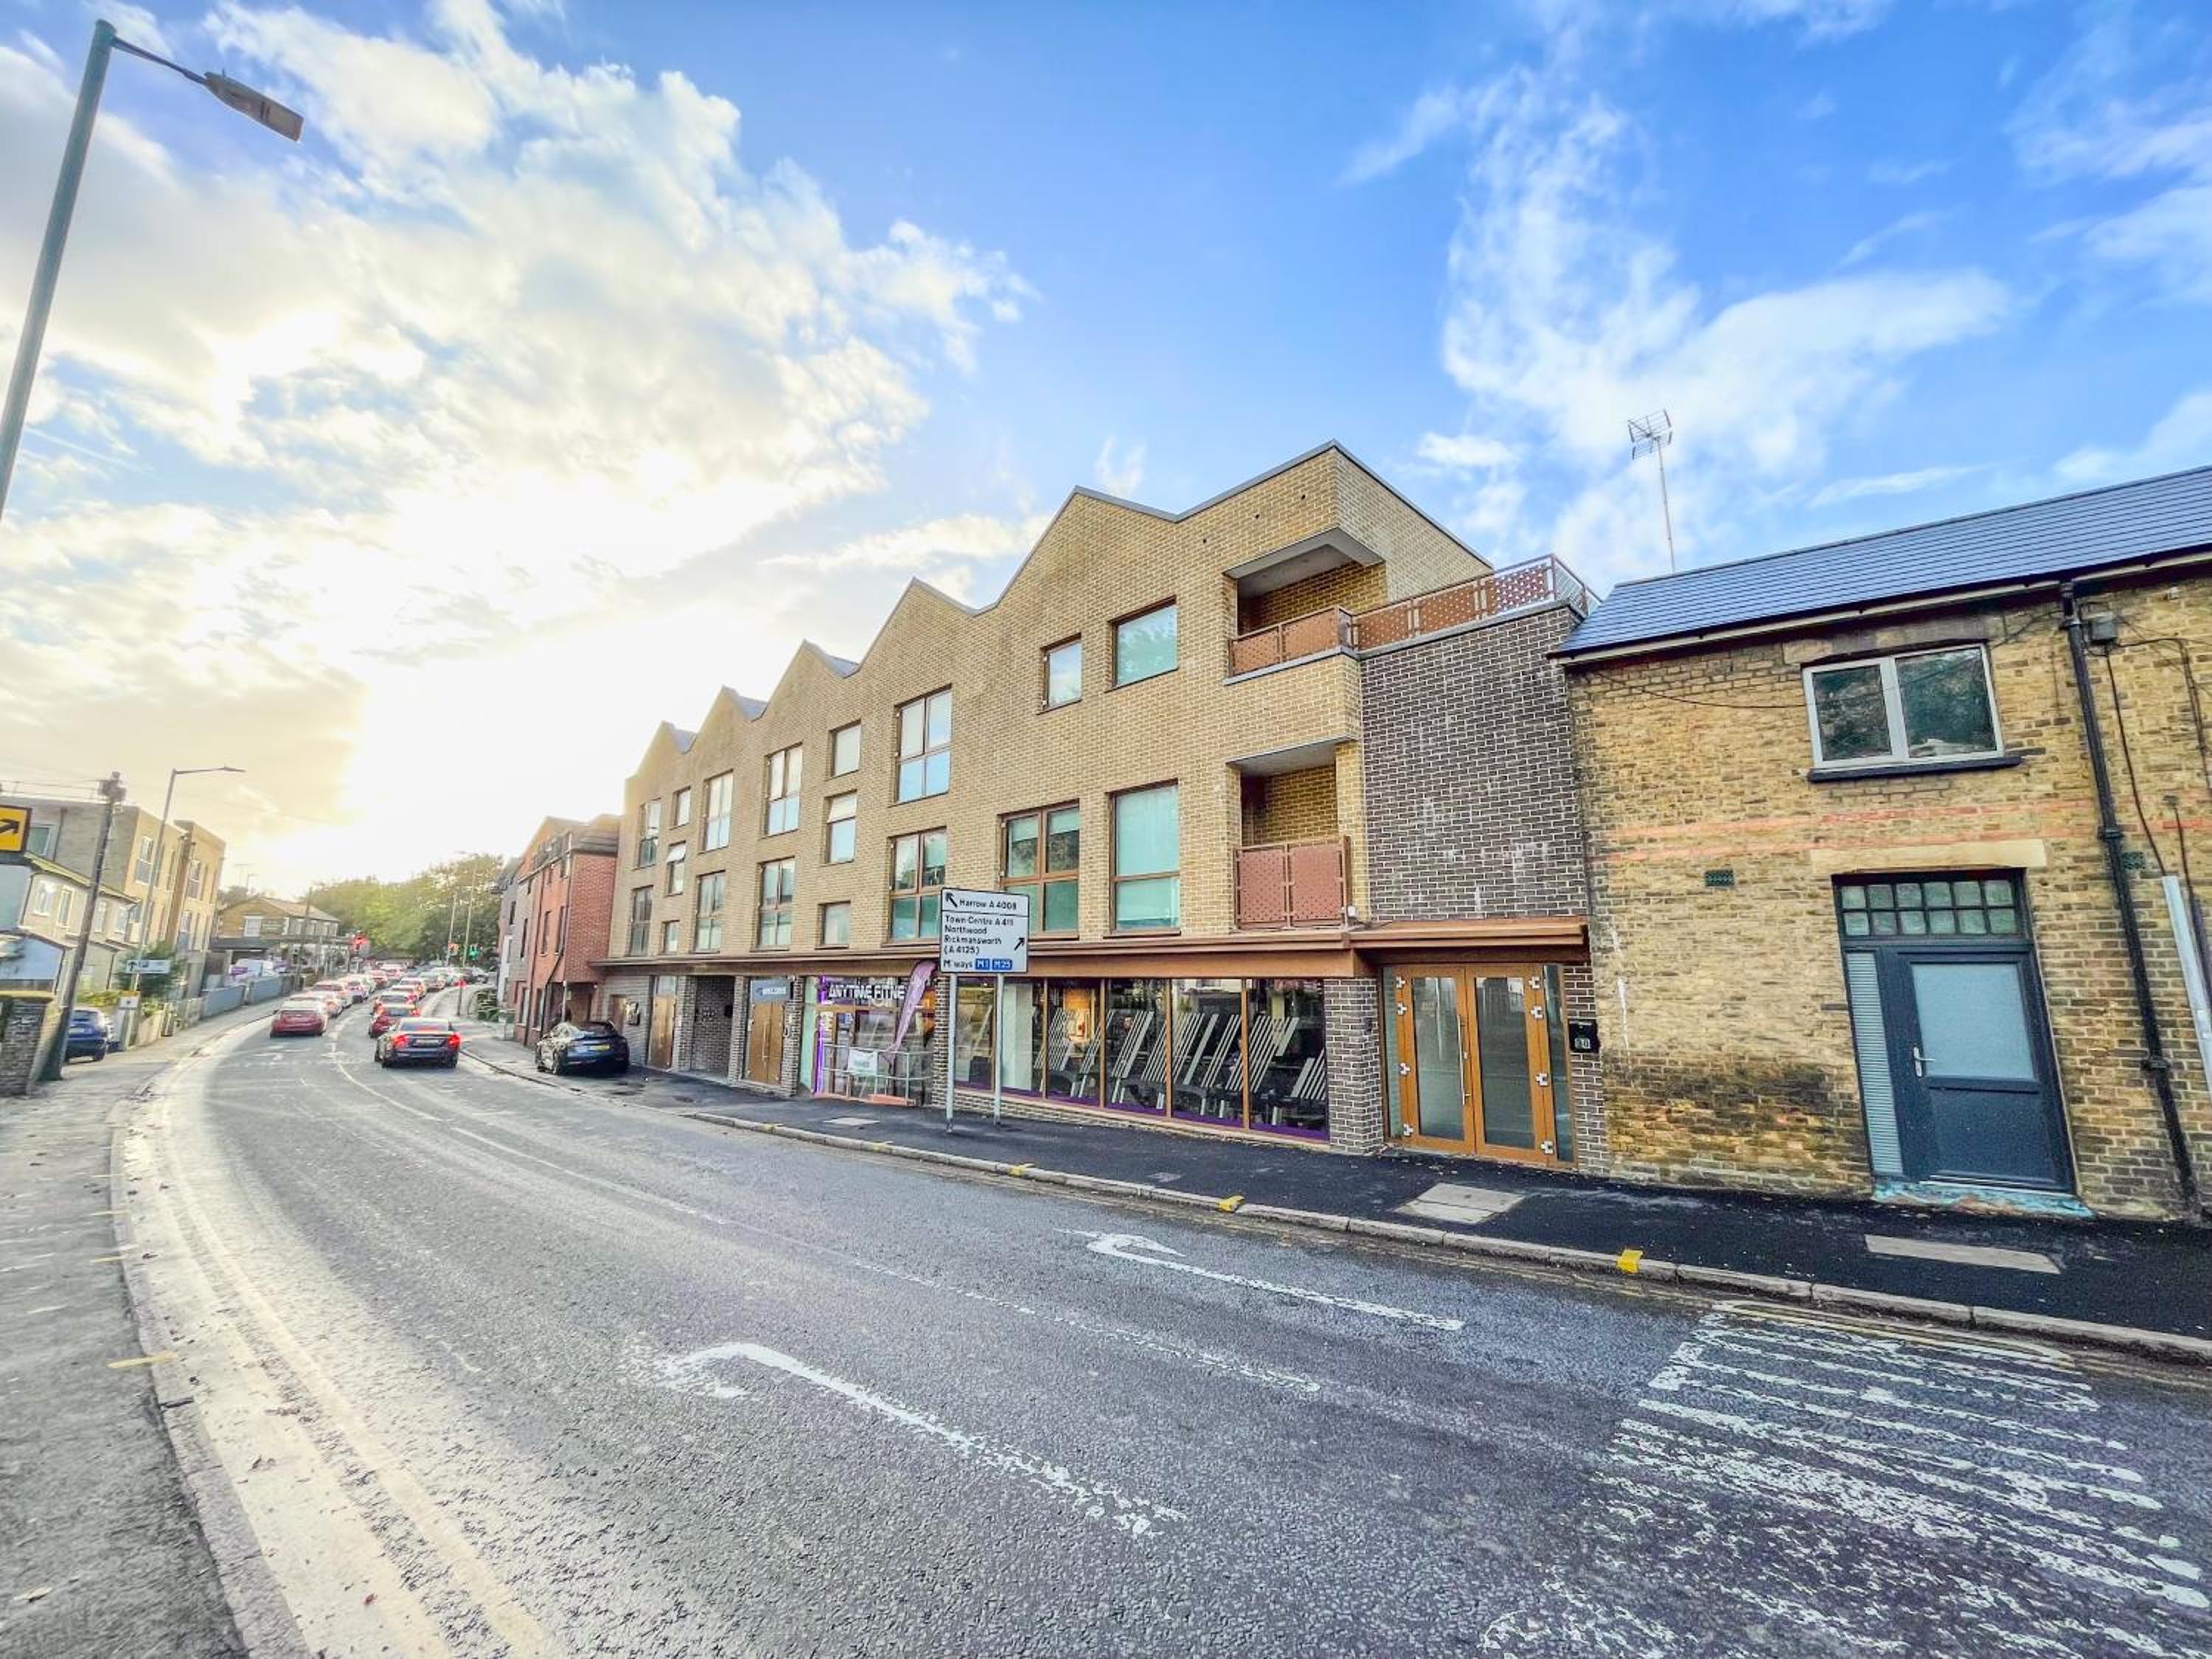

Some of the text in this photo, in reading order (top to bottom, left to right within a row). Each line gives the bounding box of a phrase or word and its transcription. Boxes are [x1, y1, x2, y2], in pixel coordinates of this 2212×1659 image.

[959, 899, 987, 908] Harrow
[945, 915, 966, 923] Town
[967, 916, 993, 925] Centre
[945, 925, 987, 934] Northwood
[944, 934, 1002, 945] Rickmansworth
[977, 960, 989, 968] M1
[994, 961, 1012, 970] M25
[829, 984, 906, 999] ANYTIME FITNE
